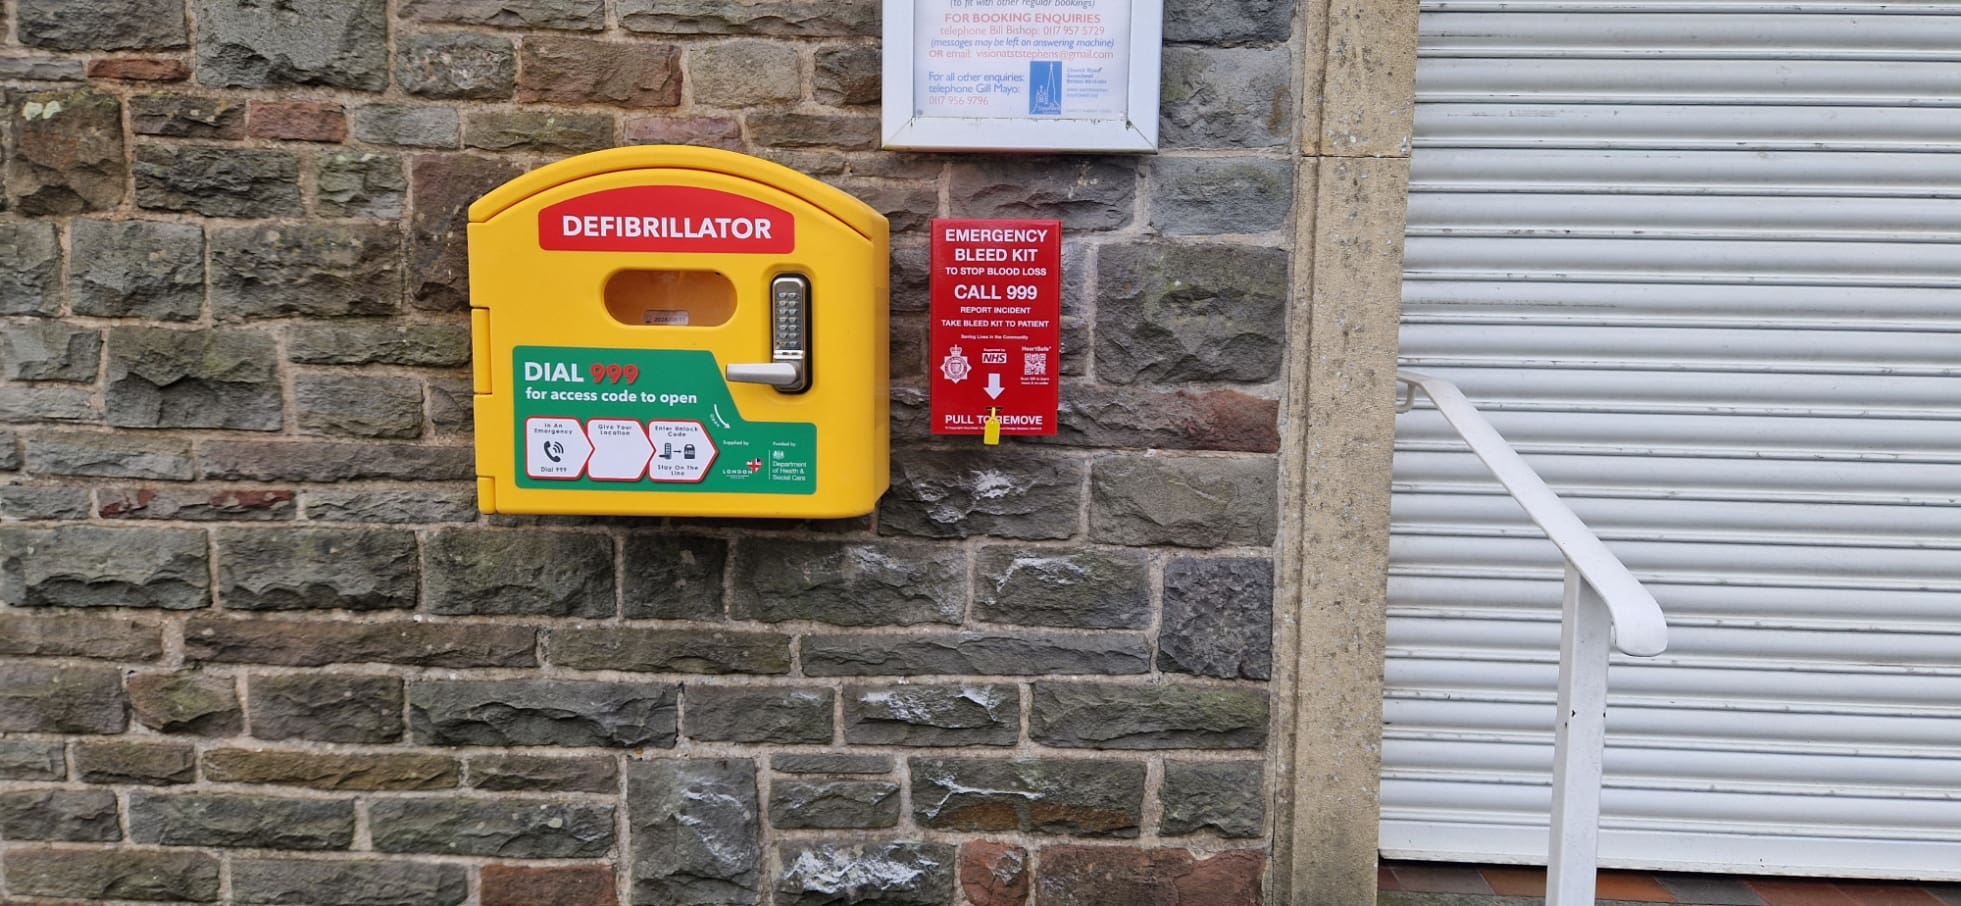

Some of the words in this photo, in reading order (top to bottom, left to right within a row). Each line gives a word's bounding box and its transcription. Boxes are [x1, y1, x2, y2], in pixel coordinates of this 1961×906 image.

[950, 0, 961, 8] (to
[965, 0, 973, 8] fit
[1021, 0, 1050, 8] regular
[1055, 0, 1095, 9] bookings)
[944, 13, 970, 23] FOR
[972, 13, 1032, 23] BOOKING
[1035, 13, 1101, 23] ENQUIRIES
[940, 25, 987, 38] telephone
[990, 25, 1003, 34] Bill
[1043, 26, 1060, 36] 0117
[1063, 26, 1079, 36] 957
[1082, 26, 1104, 36] 5729
[930, 38, 972, 48] (messages
[974, 40, 992, 48] may
[994, 38, 1004, 46] be
[1006, 38, 1018, 48] left
[1033, 39, 1074, 49] answering
[1077, 38, 1114, 48] machine)
[928, 72, 943, 81] For
[946, 72, 955, 81] all
[958, 72, 980, 81] other
[984, 72, 1024, 83] enquiries:
[928, 84, 973, 94] telephone
[976, 84, 991, 93] Gill
[928, 95, 946, 105] 0117
[948, 95, 965, 105] 956
[967, 96, 989, 106] 9796
[562, 215, 772, 239] DEFIBRILLATOR
[945, 229, 1048, 242] EMERGENCY
[955, 248, 1008, 262] BLEED
[1012, 248, 1038, 262] KIT
[946, 267, 958, 275] TO
[960, 267, 984, 275] STOP
[987, 267, 1020, 276] BLOOD
[1022, 268, 1046, 276] LOSS
[954, 284, 1001, 300] CALL
[1006, 285, 1038, 300] 999
[984, 354, 1006, 362] NHS
[524, 361, 584, 382] DIAL
[589, 362, 640, 385] 999
[526, 386, 547, 400] for
[551, 390, 598, 402] access
[601, 390, 637, 402] code
[640, 392, 656, 403] to
[660, 393, 697, 406] open
[945, 414, 974, 424] PULL
[997, 415, 1043, 424] REMOVE
